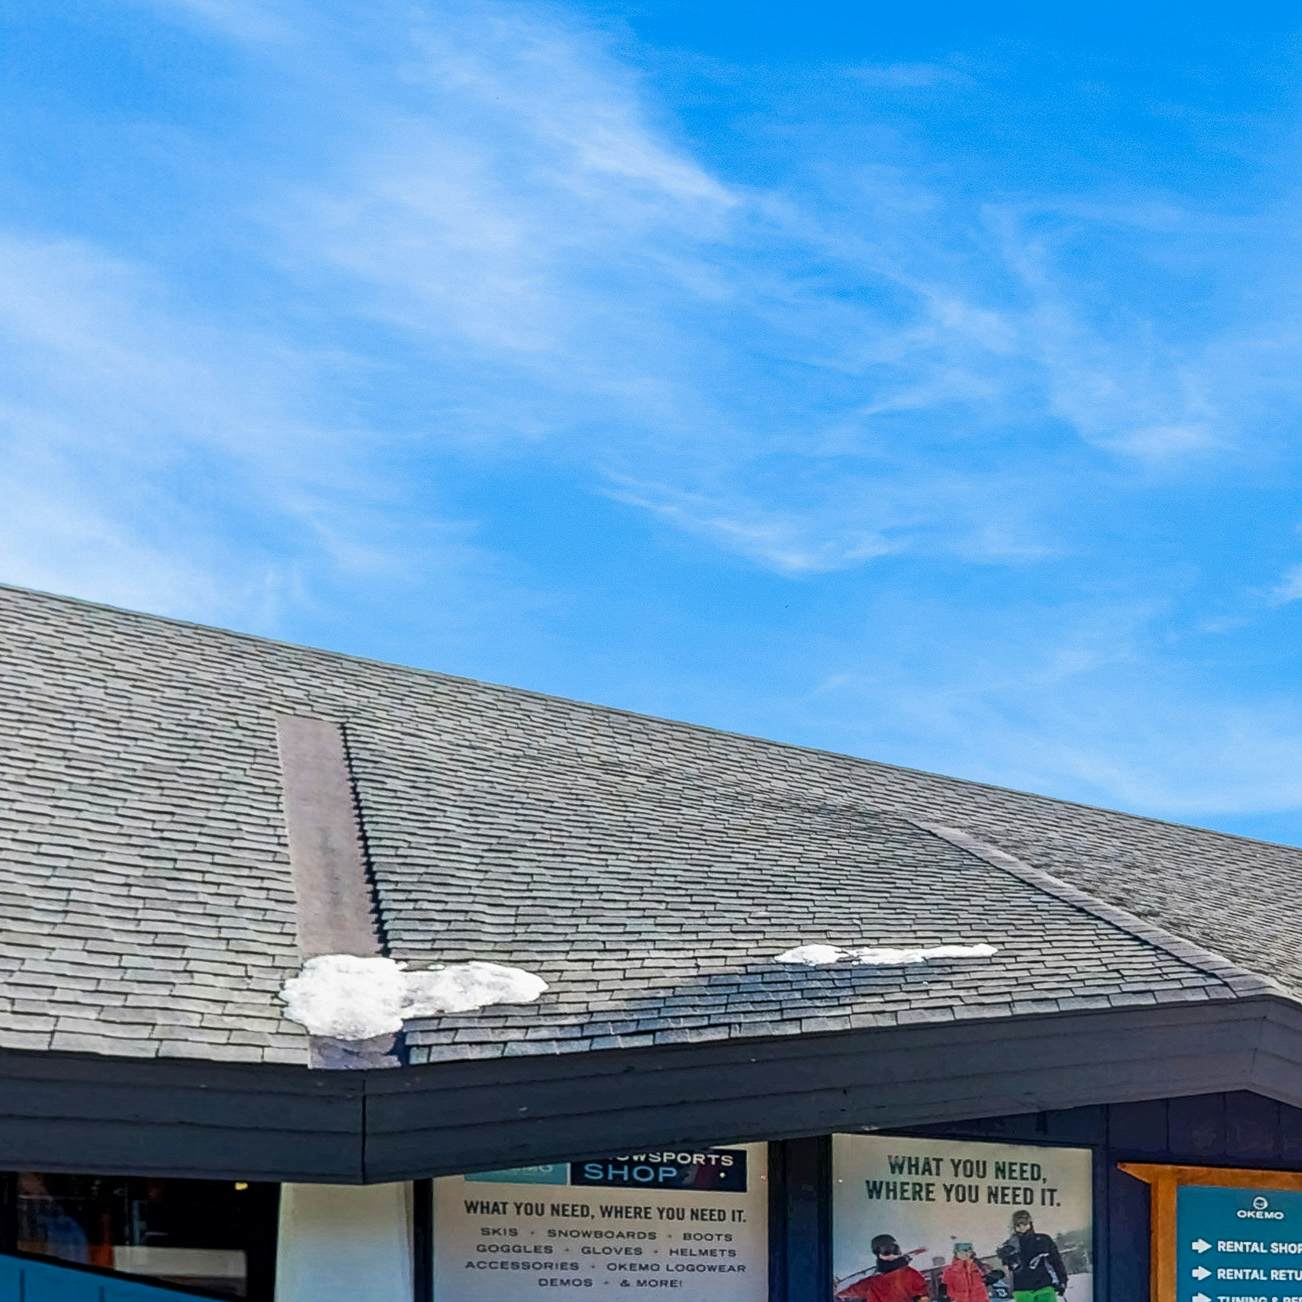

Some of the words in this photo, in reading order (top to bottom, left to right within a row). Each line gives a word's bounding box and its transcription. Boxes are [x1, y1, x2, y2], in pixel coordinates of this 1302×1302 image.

[609, 1152, 733, 1166] OWSPORTS
[583, 1163, 678, 1182] SHOP
[887, 1155, 943, 1177] WHAT
[951, 1158, 987, 1179] YOU
[995, 1161, 1047, 1184] NEED,
[866, 1180, 936, 1202] WHERE
[942, 1183, 979, 1204] YOU
[987, 1186, 1034, 1206] NEED
[1041, 1188, 1061, 1207] IT.
[464, 1200, 508, 1215] WHAT
[514, 1202, 545, 1216] YOU
[551, 1203, 595, 1220] NEED,
[600, 1205, 652, 1219] WHERE
[657, 1207, 685, 1220] YOU
[690, 1208, 726, 1222] NEED
[732, 1209, 747, 1223] IT.
[1236, 1210, 1284, 1220] OKEMO
[480, 1227, 518, 1237] SKIS
[547, 1229, 657, 1240] SNOWBOARDS
[683, 1232, 733, 1242] BOOTS
[476, 1244, 553, 1254] GOGGLES
[581, 1246, 643, 1256] GLOVES
[669, 1248, 737, 1258] HELMETS
[1217, 1241, 1268, 1253] RENTAL
[465, 1260, 580, 1271] ACCESSORIES
[606, 1262, 660, 1272] OKEMO
[666, 1263, 747, 1273] LOGOWEAR
[1217, 1268, 1268, 1280] RENTAL
[538, 1278, 593, 1287] DEMOS
[620, 1279, 630, 1288] &
[636, 1279, 683, 1288] MORE!
